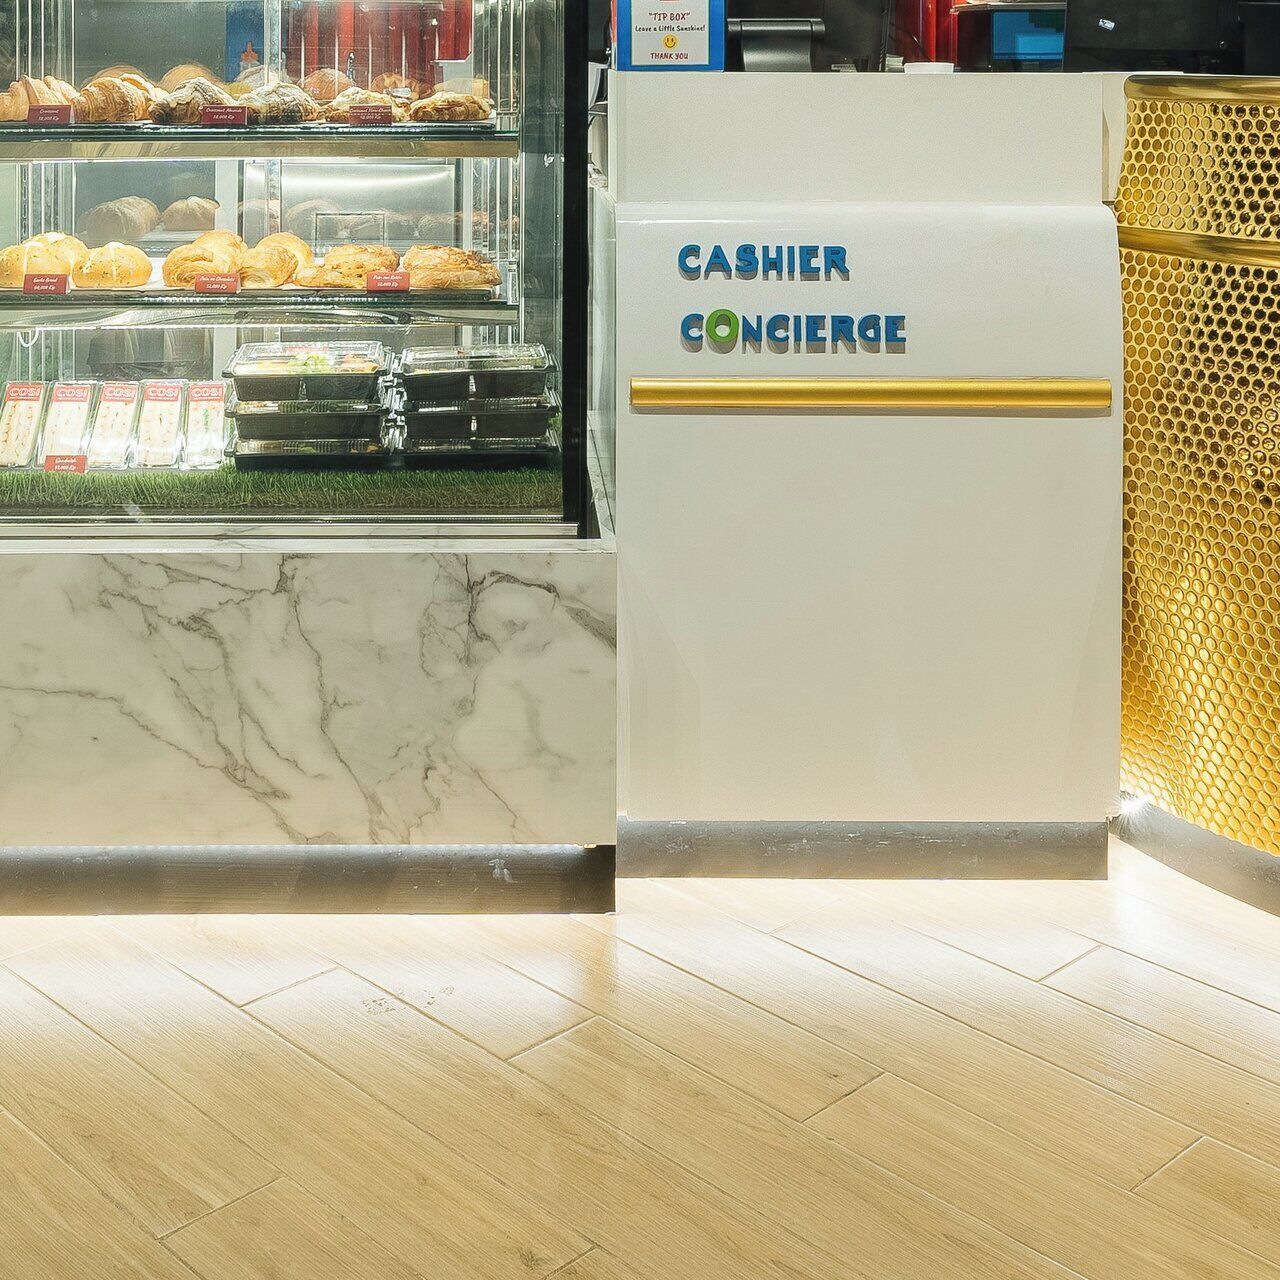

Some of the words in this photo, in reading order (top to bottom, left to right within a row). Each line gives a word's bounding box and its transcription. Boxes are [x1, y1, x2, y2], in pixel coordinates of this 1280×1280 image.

[650, 52, 673, 60] THANK
[678, 244, 850, 278] CASHIER
[681, 308, 907, 351] CONCIERGE
[10, 388, 40, 397] COSI
[57, 388, 87, 397] COSI
[104, 388, 136, 397] COSI
[148, 388, 178, 397] COSI
[192, 388, 222, 397] COSI
